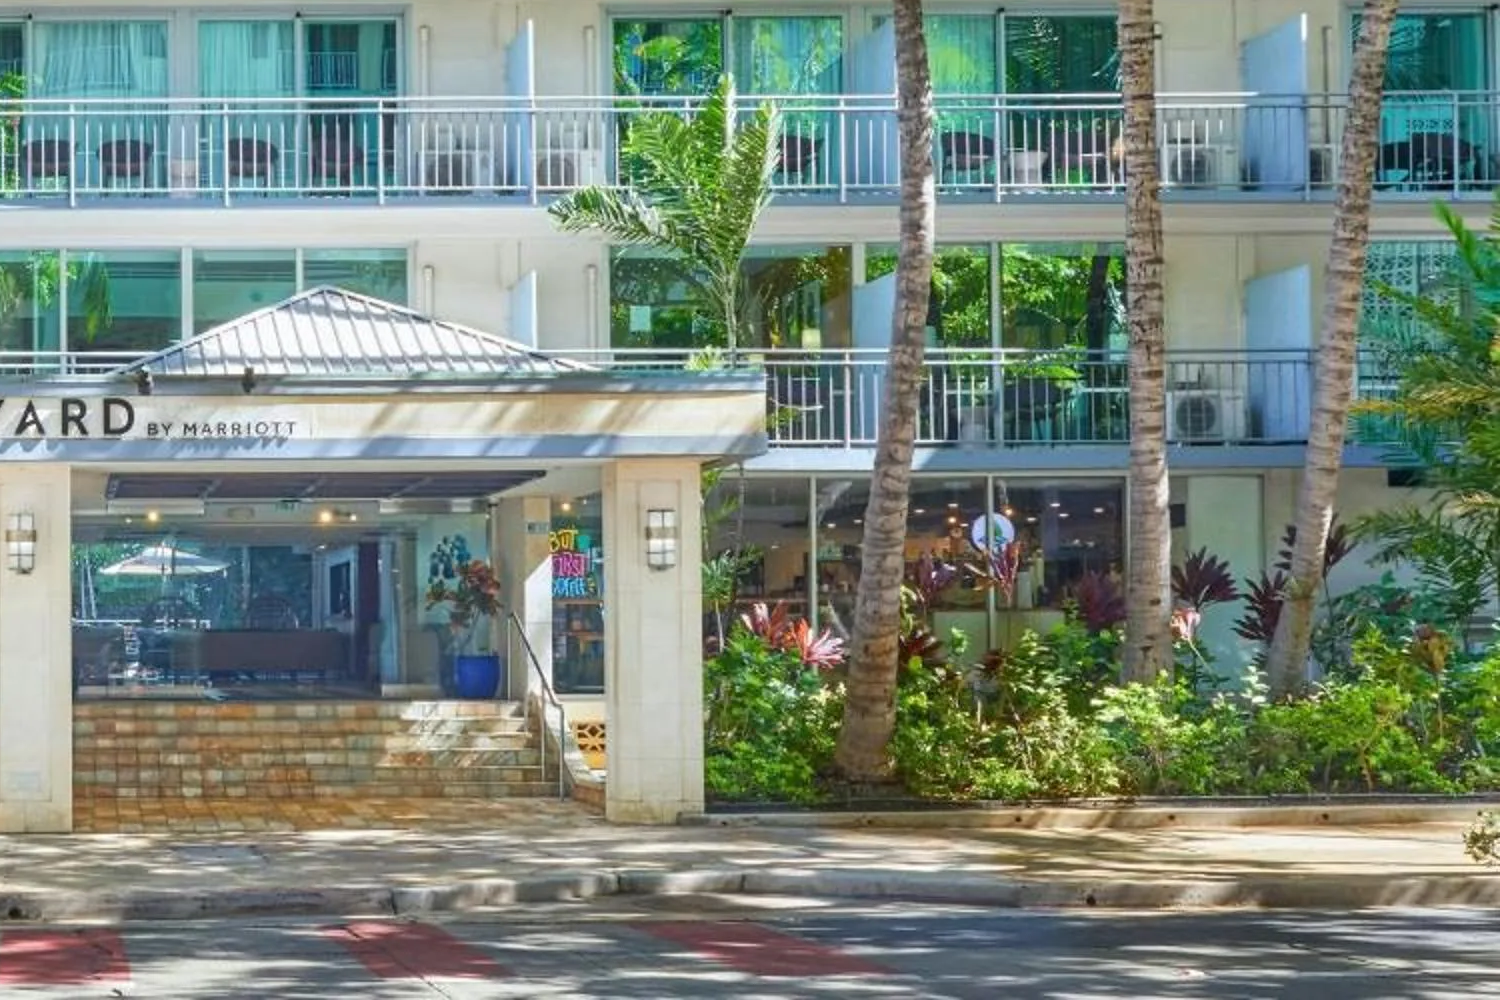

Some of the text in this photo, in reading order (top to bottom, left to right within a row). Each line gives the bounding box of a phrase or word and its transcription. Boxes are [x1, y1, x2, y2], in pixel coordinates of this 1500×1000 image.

[147, 422, 173, 436] BY
[182, 421, 297, 436] MARRIOTT
[548, 529, 579, 552] BUT
